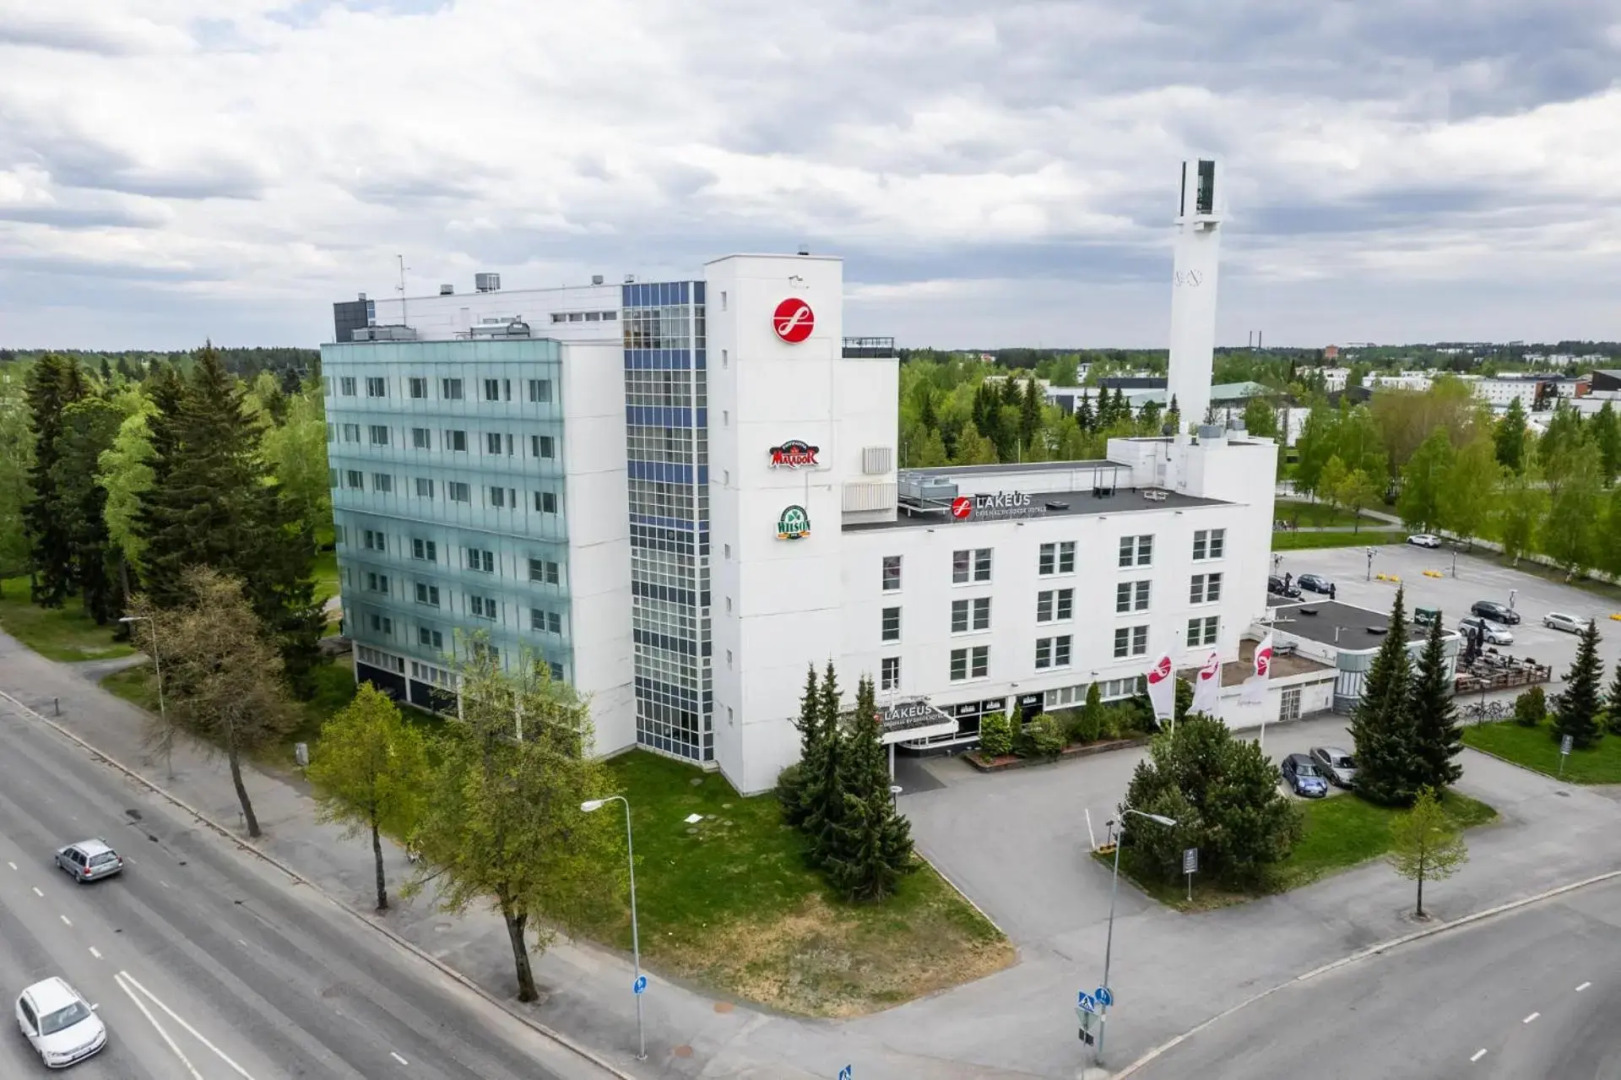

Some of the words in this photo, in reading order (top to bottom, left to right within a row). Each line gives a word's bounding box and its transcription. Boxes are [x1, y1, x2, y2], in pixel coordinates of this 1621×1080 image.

[976, 494, 1031, 508] LAKEUS
[777, 520, 811, 533] WILSON
[884, 705, 932, 720] LAKEUS
